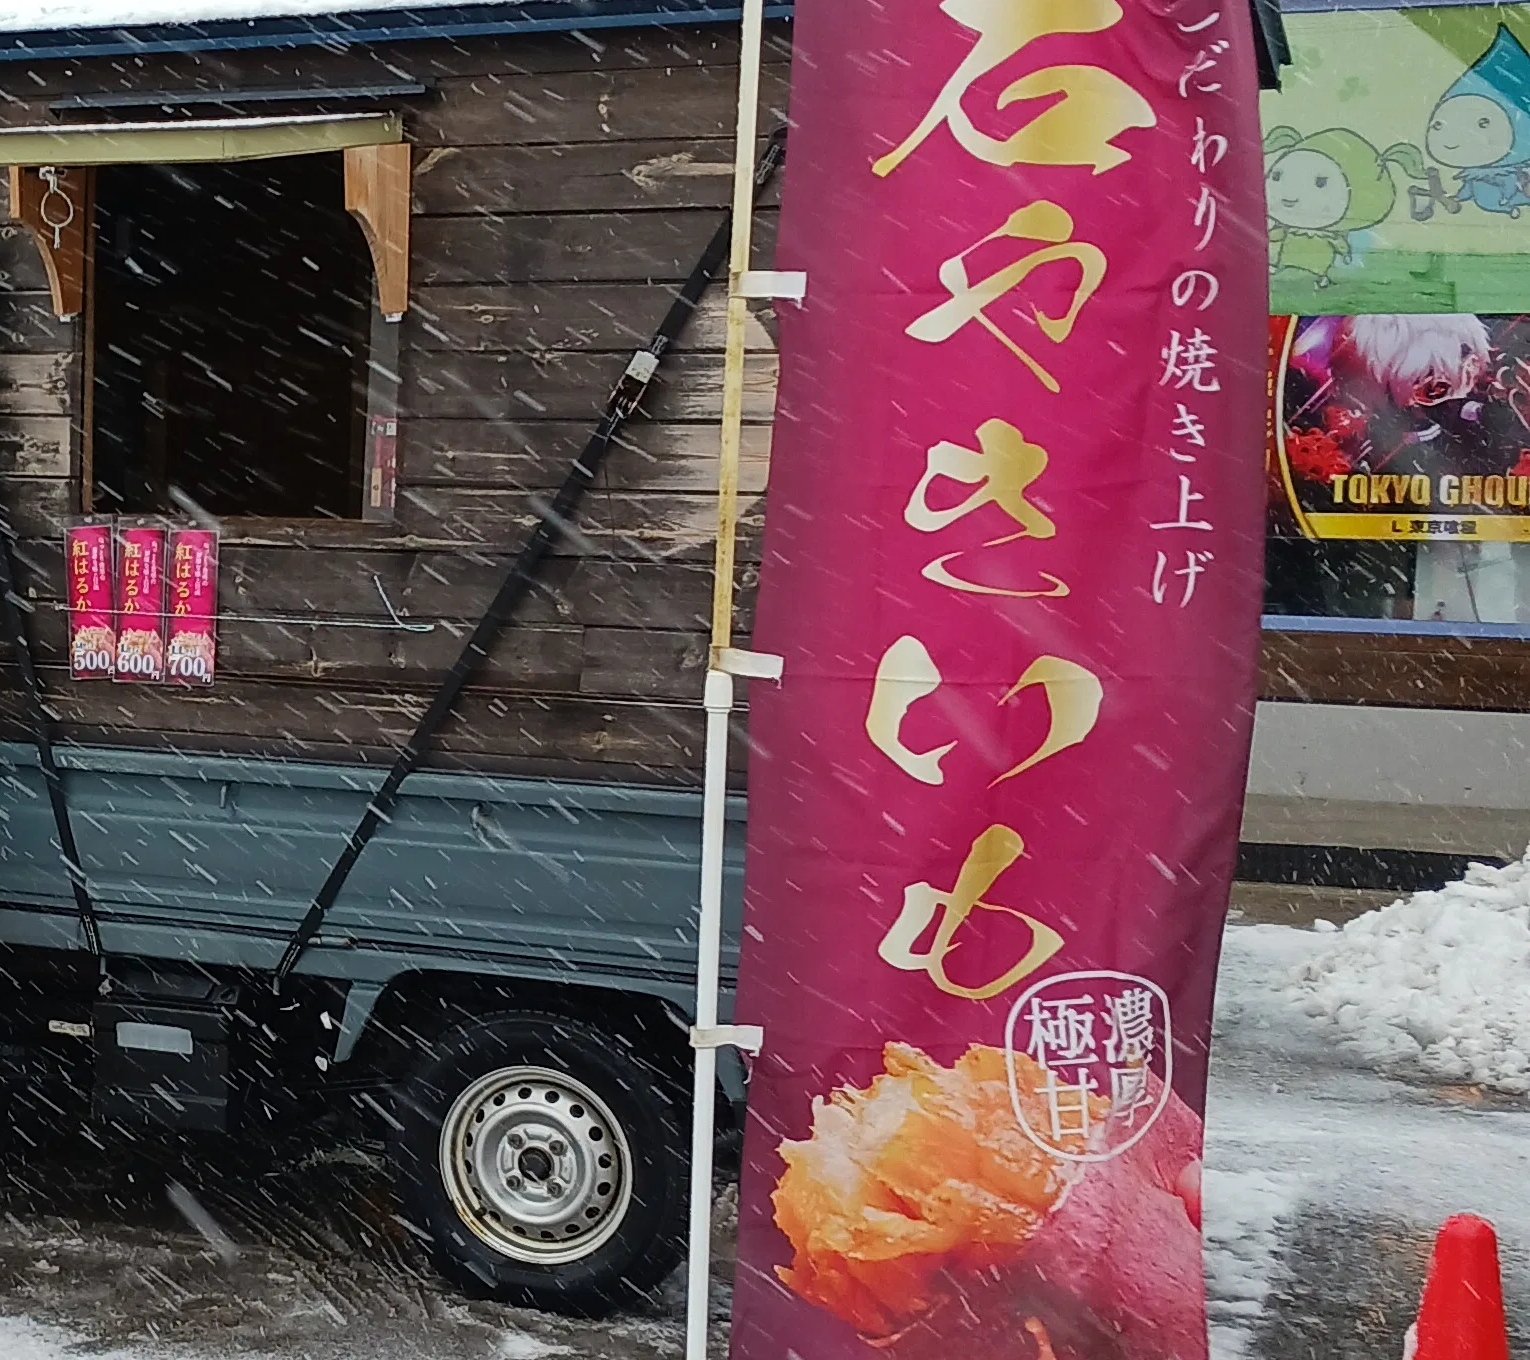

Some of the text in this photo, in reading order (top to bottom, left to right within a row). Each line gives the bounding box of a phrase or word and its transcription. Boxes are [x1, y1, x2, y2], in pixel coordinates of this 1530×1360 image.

[1330, 473, 1530, 508] TOKYO GHOU
[71, 539, 92, 612] 紅はるか
[124, 541, 142, 614] 紅はるか
[174, 542, 193, 616] 紅はるか
[1023, 993, 1099, 1142] 極甘
